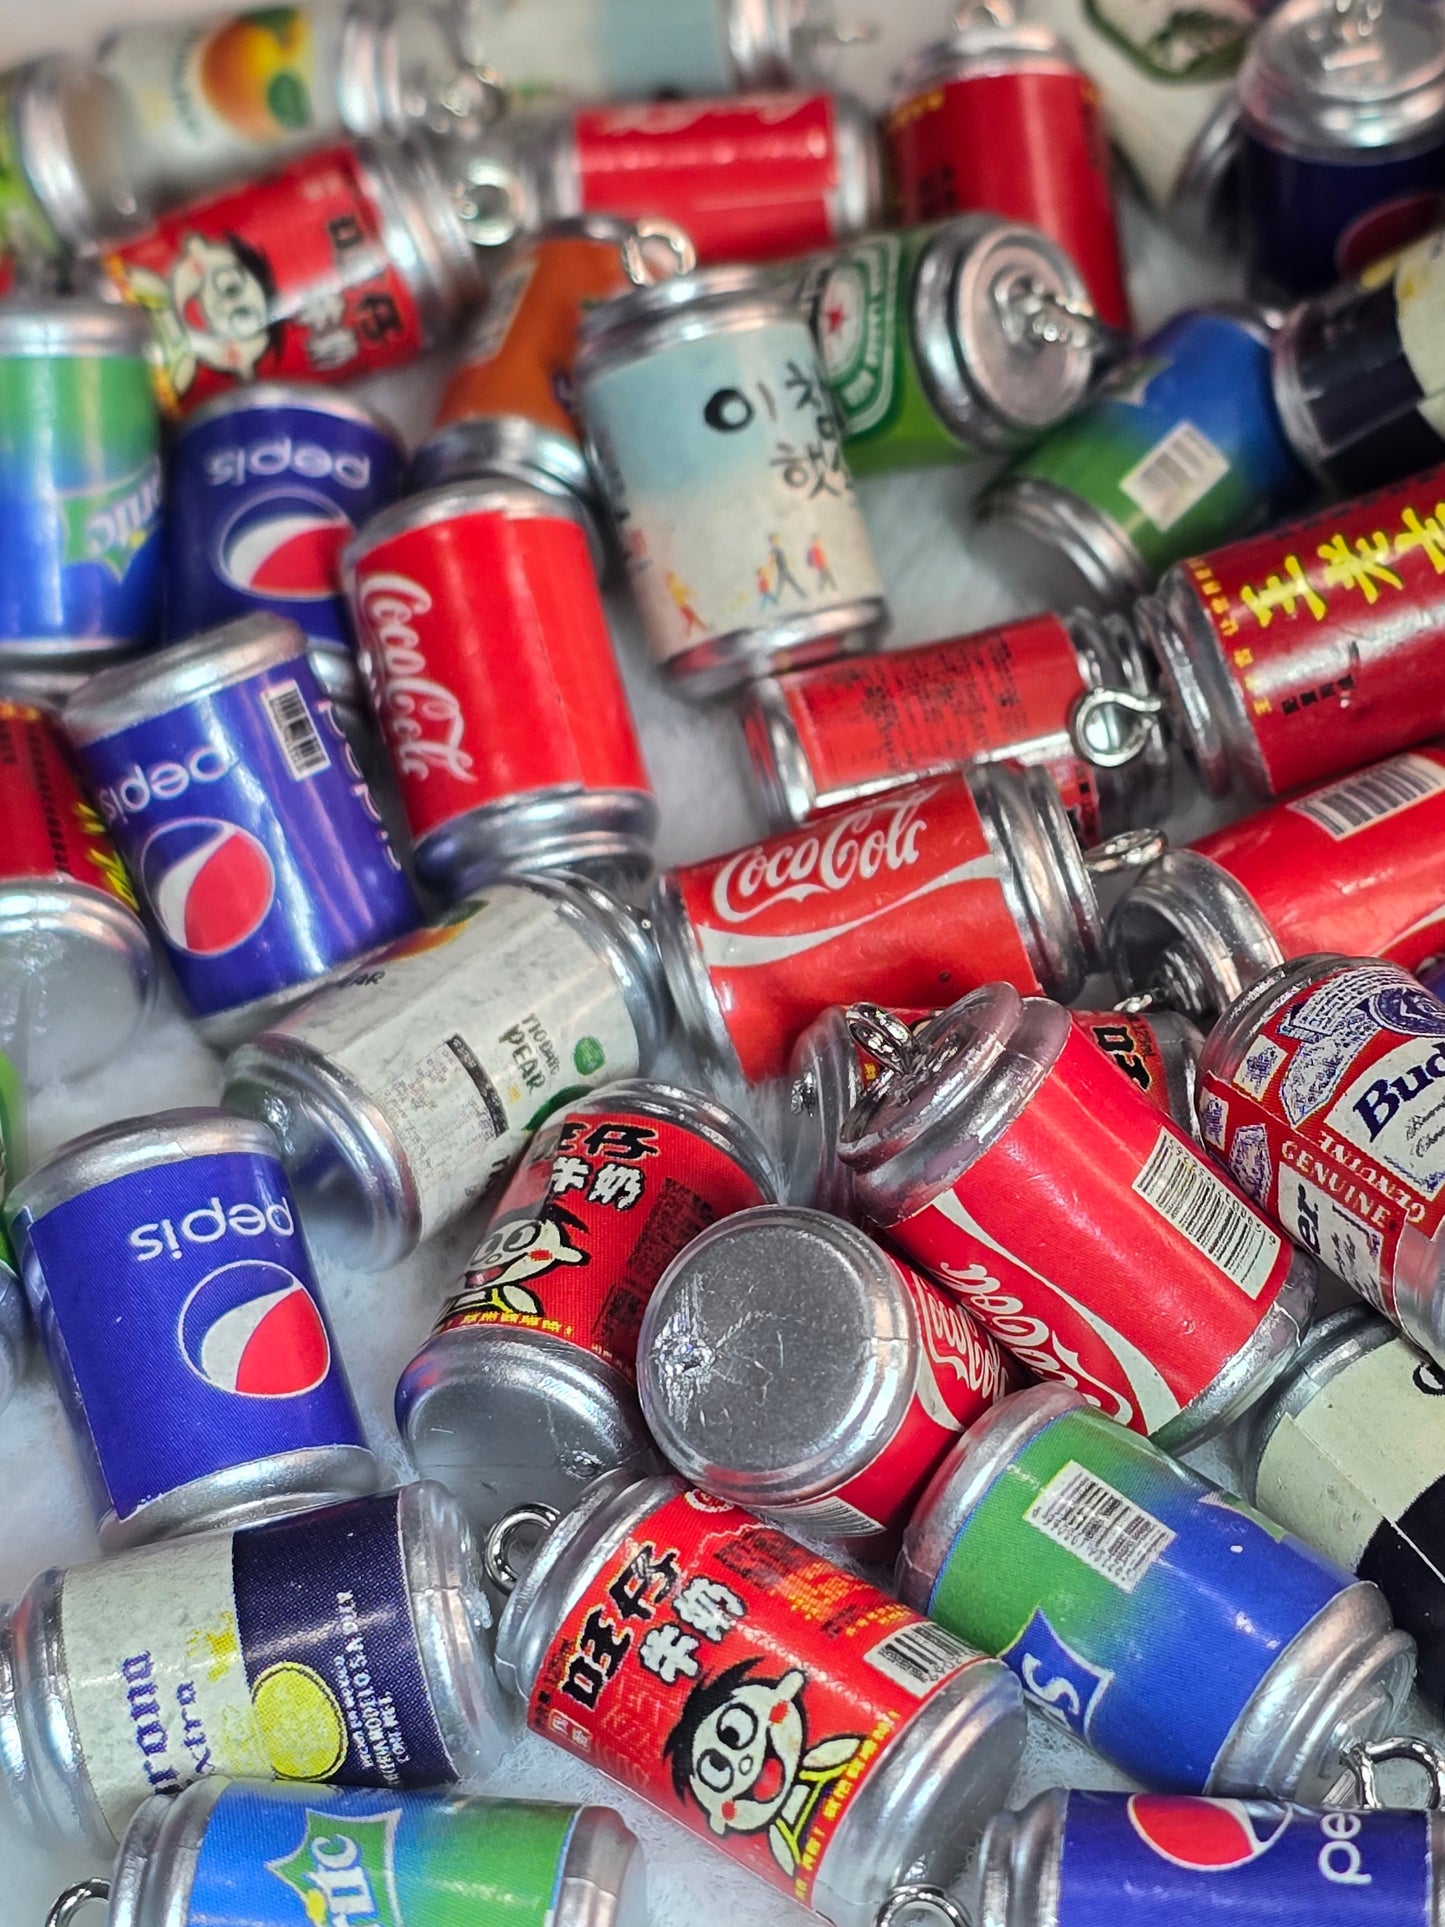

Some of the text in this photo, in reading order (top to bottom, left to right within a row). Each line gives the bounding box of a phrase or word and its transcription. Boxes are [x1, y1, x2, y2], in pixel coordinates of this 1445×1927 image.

[99, 744, 242, 825] pepis
[500, 1023, 548, 1095] PEAR
[1281, 1140, 1393, 1230] GENUINE
[130, 1197, 294, 1262] pepis
[560, 1543, 682, 1707] 旺仔
[637, 1576, 748, 1684] 牛奶
[1021, 1652, 1081, 1724] S
[1319, 1811, 1373, 1885] pe
